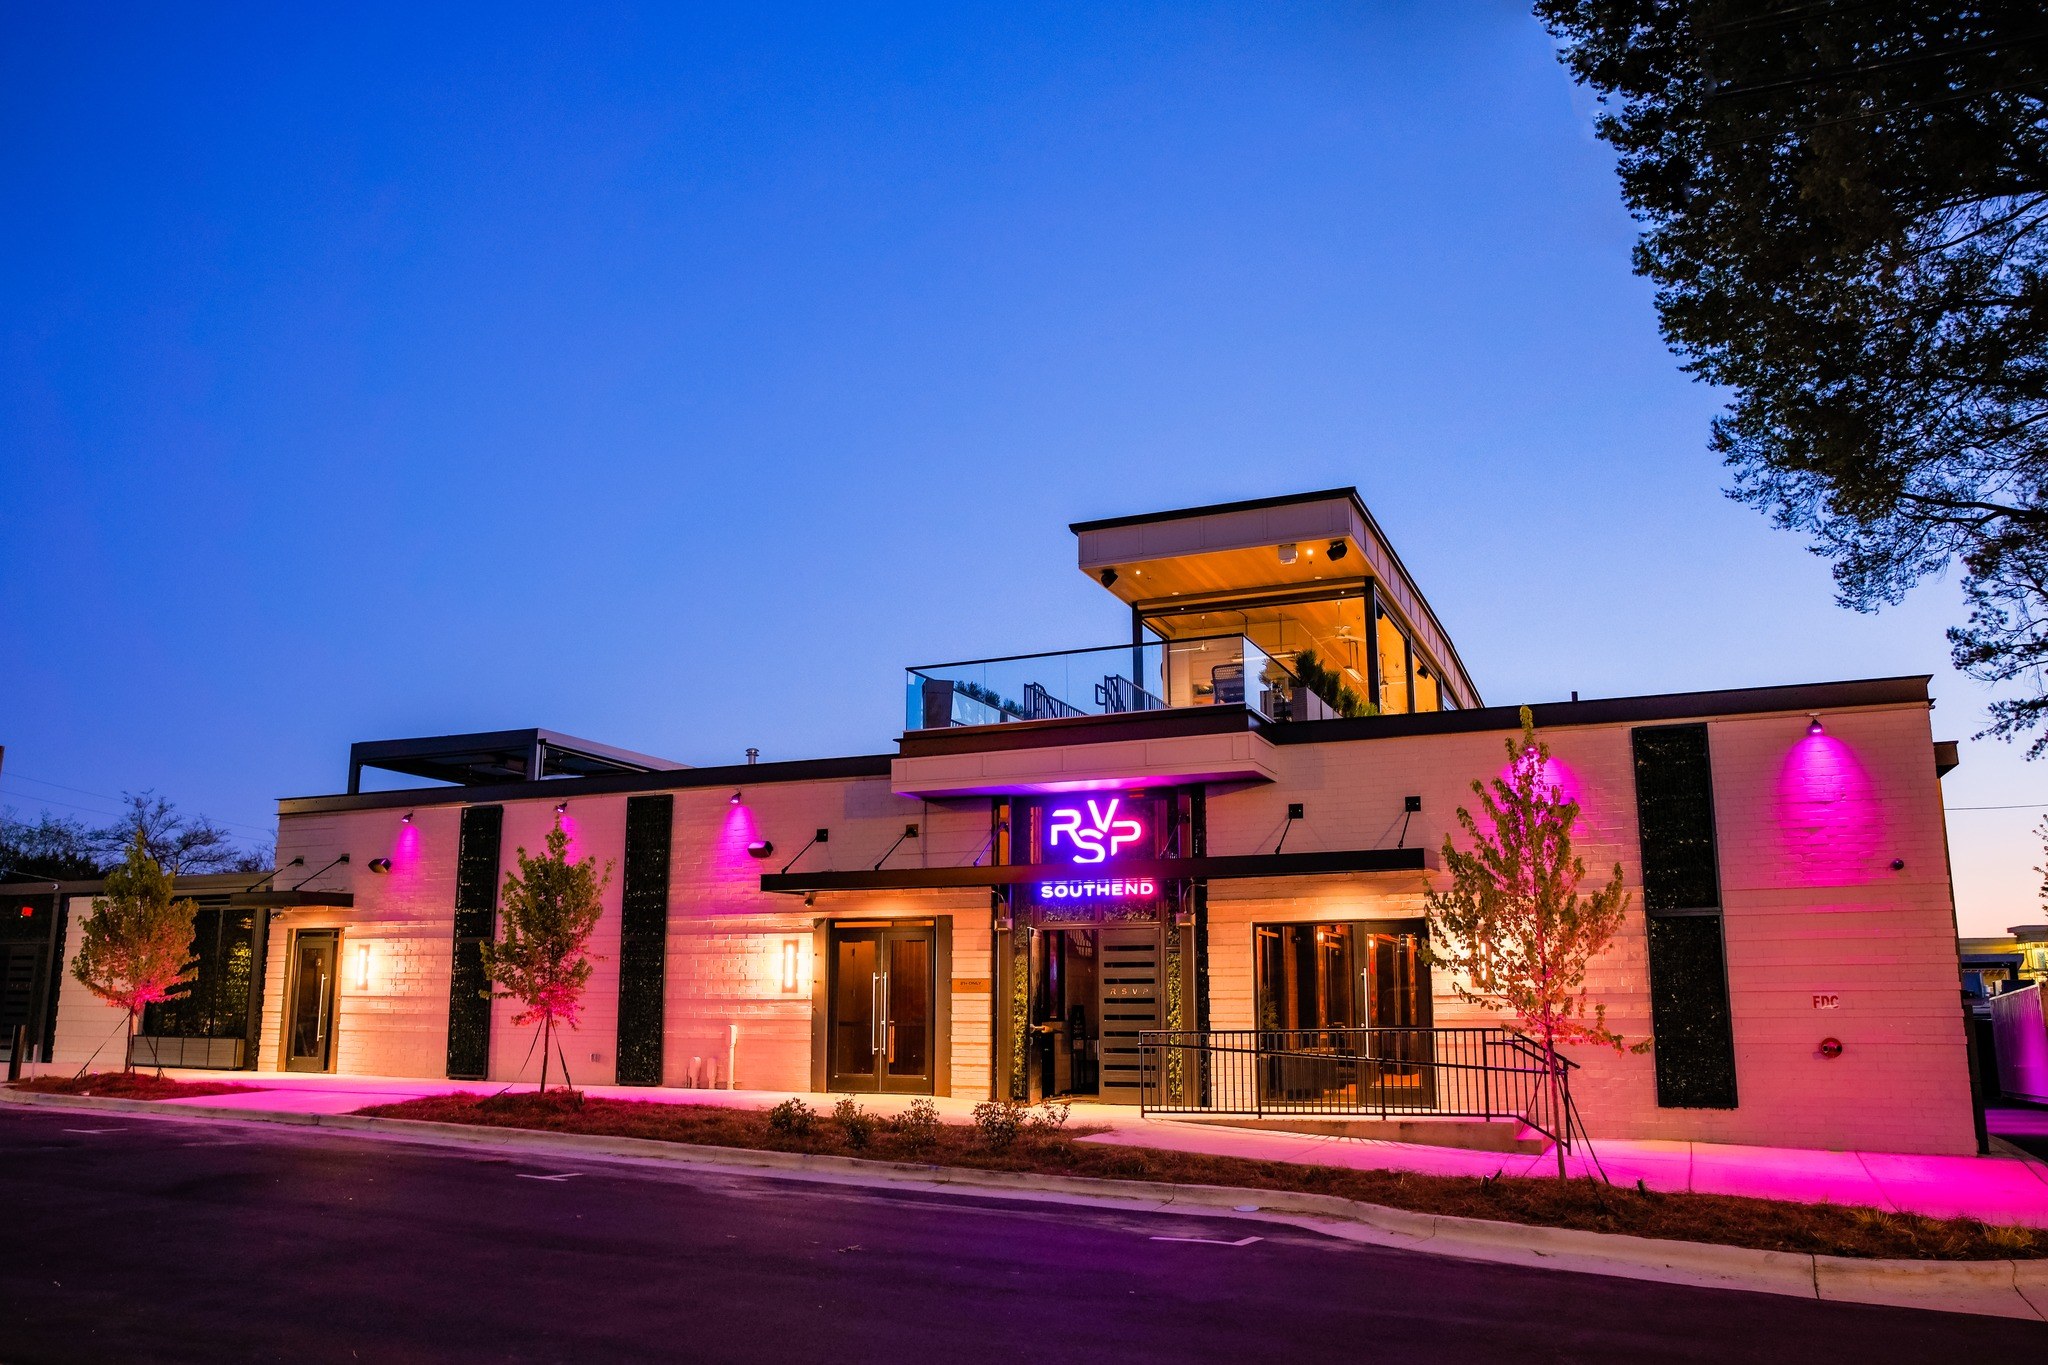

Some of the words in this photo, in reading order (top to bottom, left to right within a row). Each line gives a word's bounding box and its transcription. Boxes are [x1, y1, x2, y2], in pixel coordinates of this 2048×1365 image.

[1051, 799, 1142, 864] RSVP
[1041, 882, 1154, 899] SOUTHEND
[1812, 995, 1839, 1009] FDC
